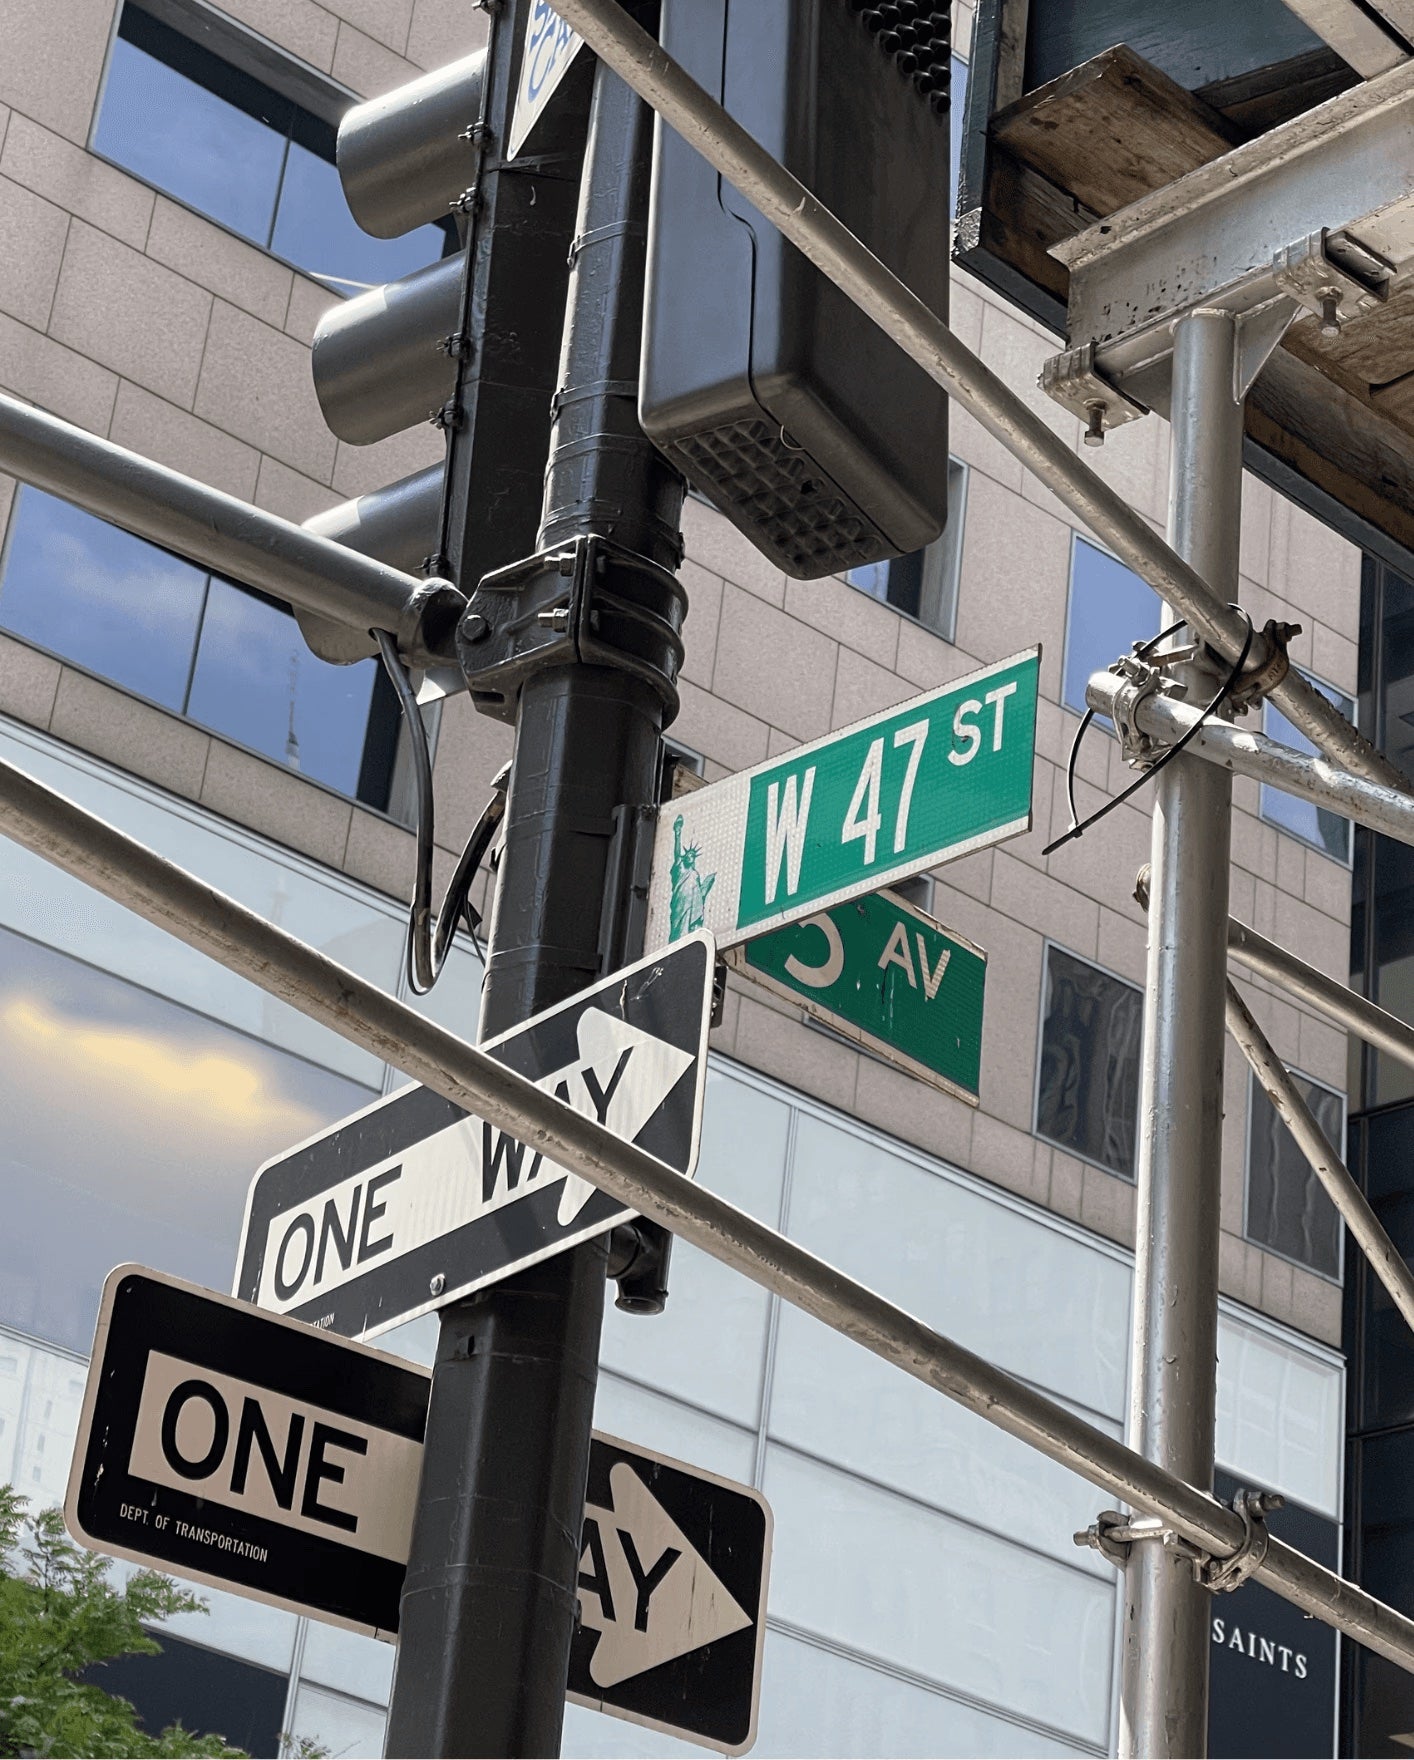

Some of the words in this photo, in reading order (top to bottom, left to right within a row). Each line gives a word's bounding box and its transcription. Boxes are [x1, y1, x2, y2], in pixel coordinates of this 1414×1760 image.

[764, 766, 816, 905] W
[841, 718, 930, 866] 47
[947, 681, 1018, 767] ST
[877, 921, 952, 1002] AV
[273, 1163, 403, 1302] ONE
[155, 1514, 171, 1531] OF
[175, 1520, 269, 1563] TRANSPORTATION
[161, 1379, 369, 1534] ONE
[577, 1517, 683, 1634] AY
[1211, 1618, 1308, 1679] SAINTS
